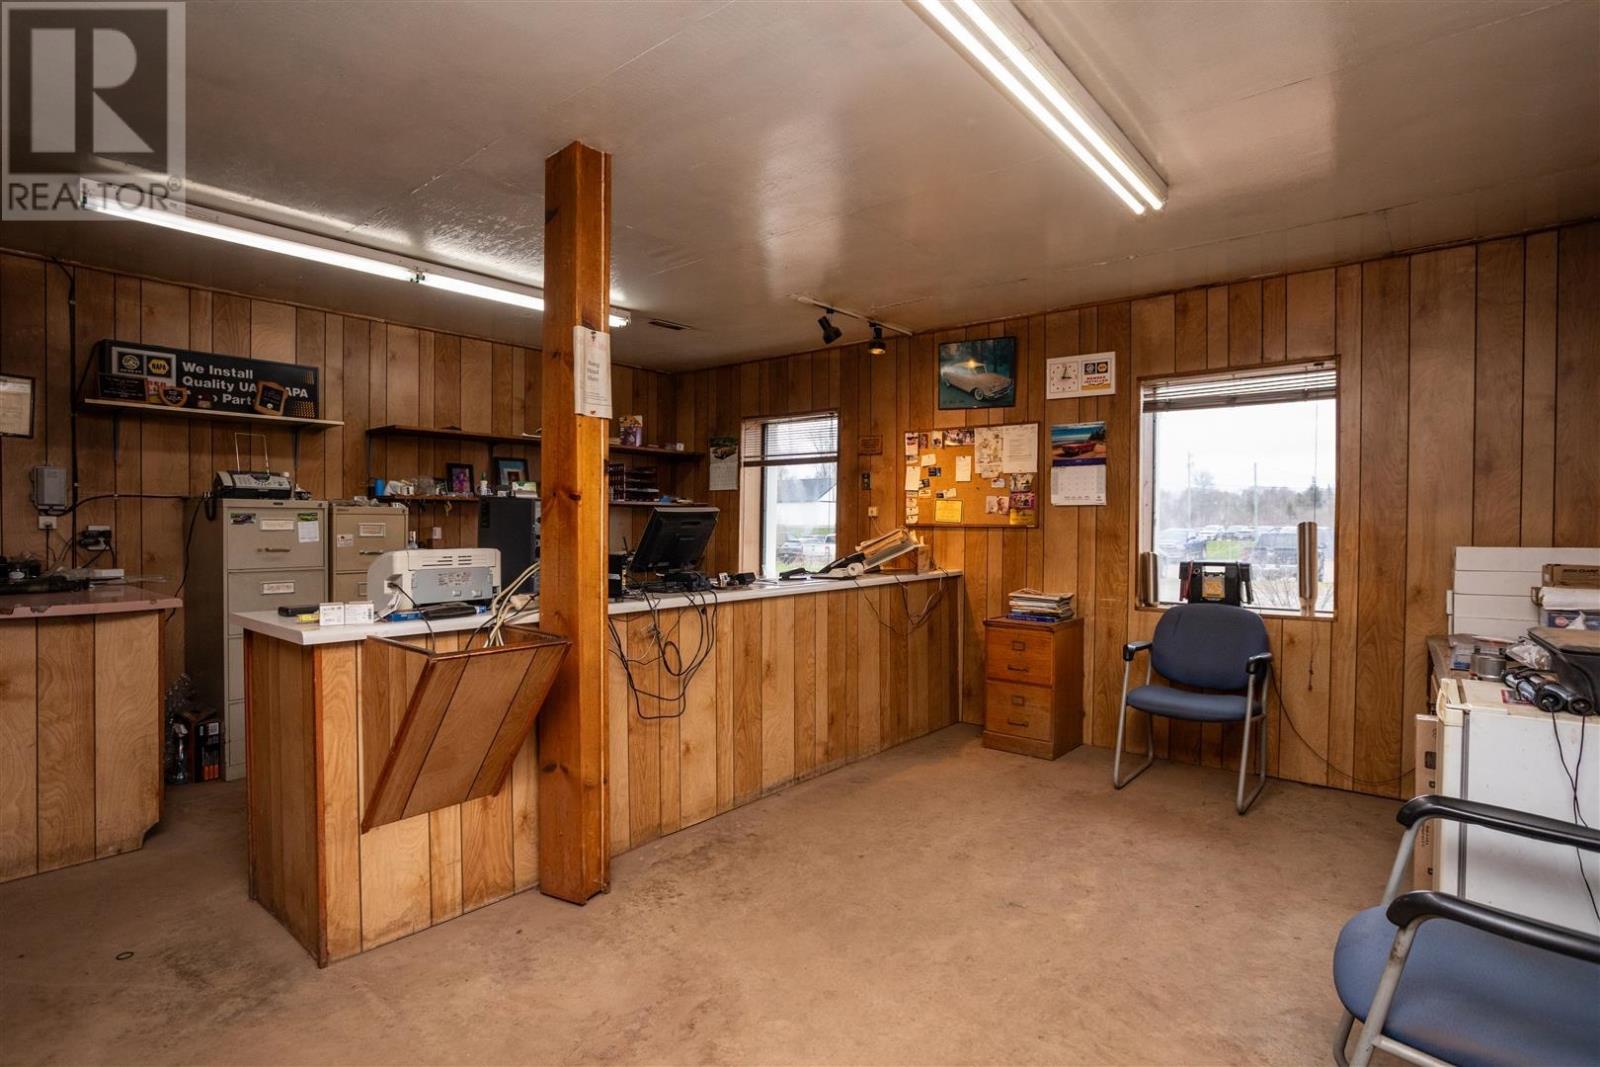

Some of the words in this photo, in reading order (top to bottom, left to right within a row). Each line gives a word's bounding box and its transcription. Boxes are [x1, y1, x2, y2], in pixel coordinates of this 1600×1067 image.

[182, 361, 205, 374] We
[209, 364, 254, 379] Install
[182, 375, 235, 393] Quality
[222, 393, 252, 406] Part
